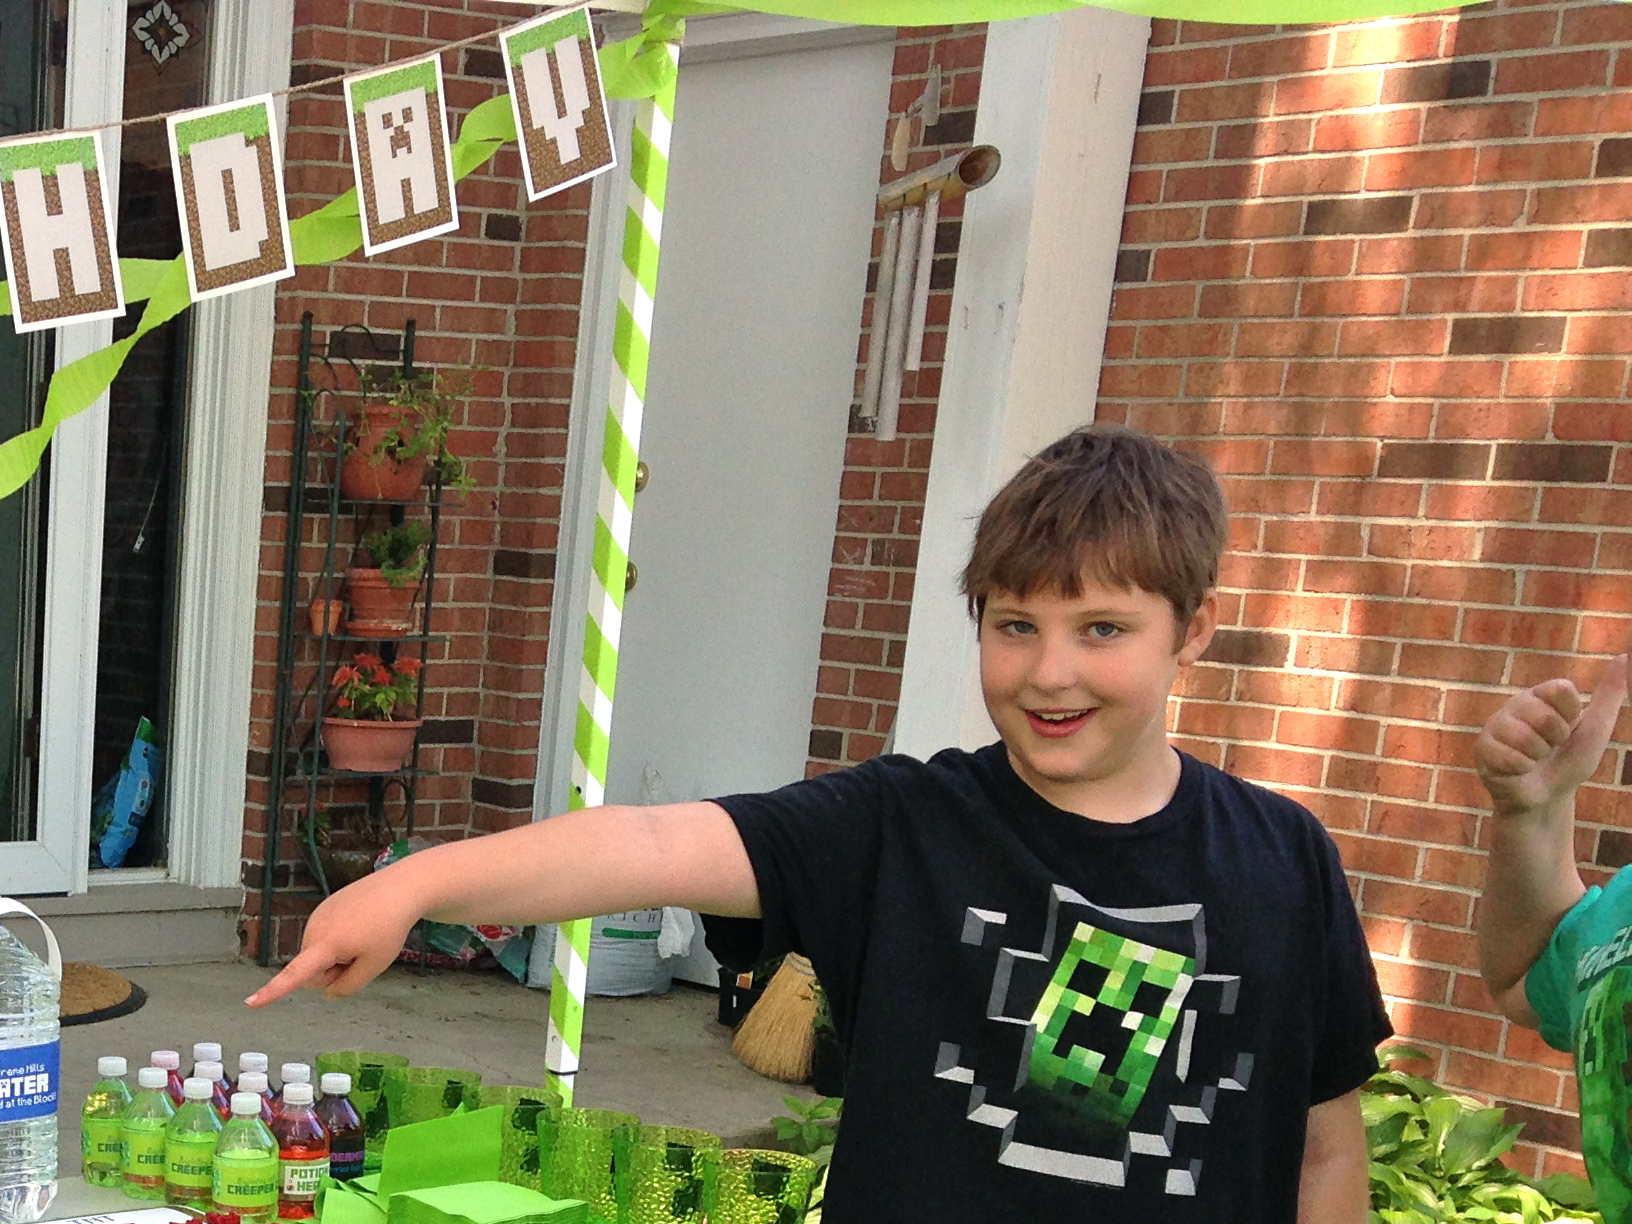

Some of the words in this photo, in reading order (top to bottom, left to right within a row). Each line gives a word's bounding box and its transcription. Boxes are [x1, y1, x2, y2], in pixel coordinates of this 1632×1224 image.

[4, 1098, 15, 1109] at
[17, 1097, 33, 1107] the
[227, 1183, 274, 1196] CREEPER
